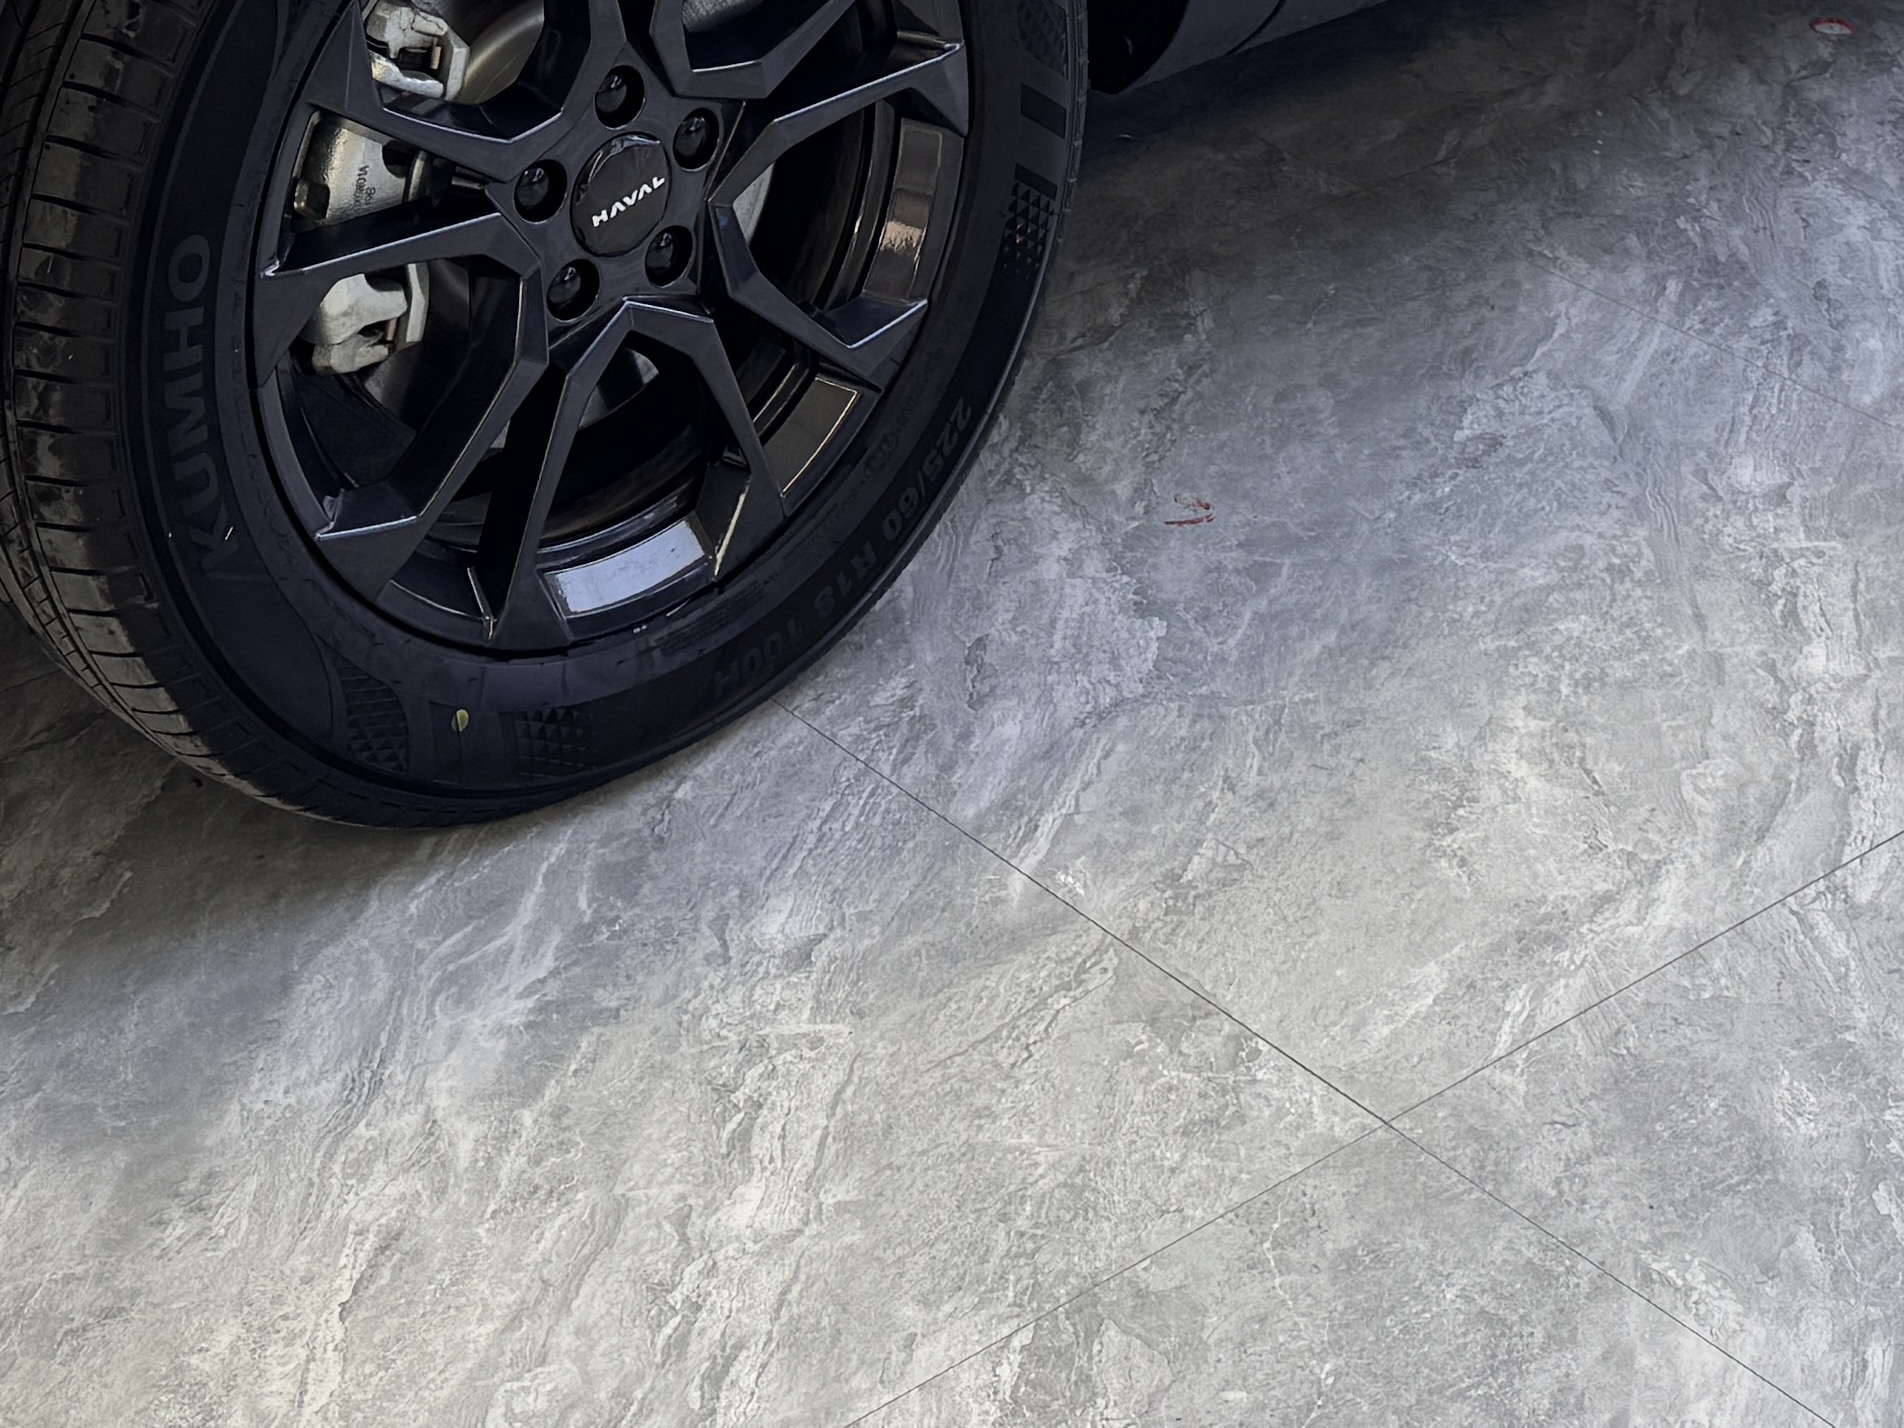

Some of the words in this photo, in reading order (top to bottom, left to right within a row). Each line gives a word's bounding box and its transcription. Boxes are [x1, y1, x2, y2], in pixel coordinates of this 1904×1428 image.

[591, 175, 666, 228] HAVAL
[162, 233, 240, 573] KUMHO
[882, 396, 974, 542] 225/60
